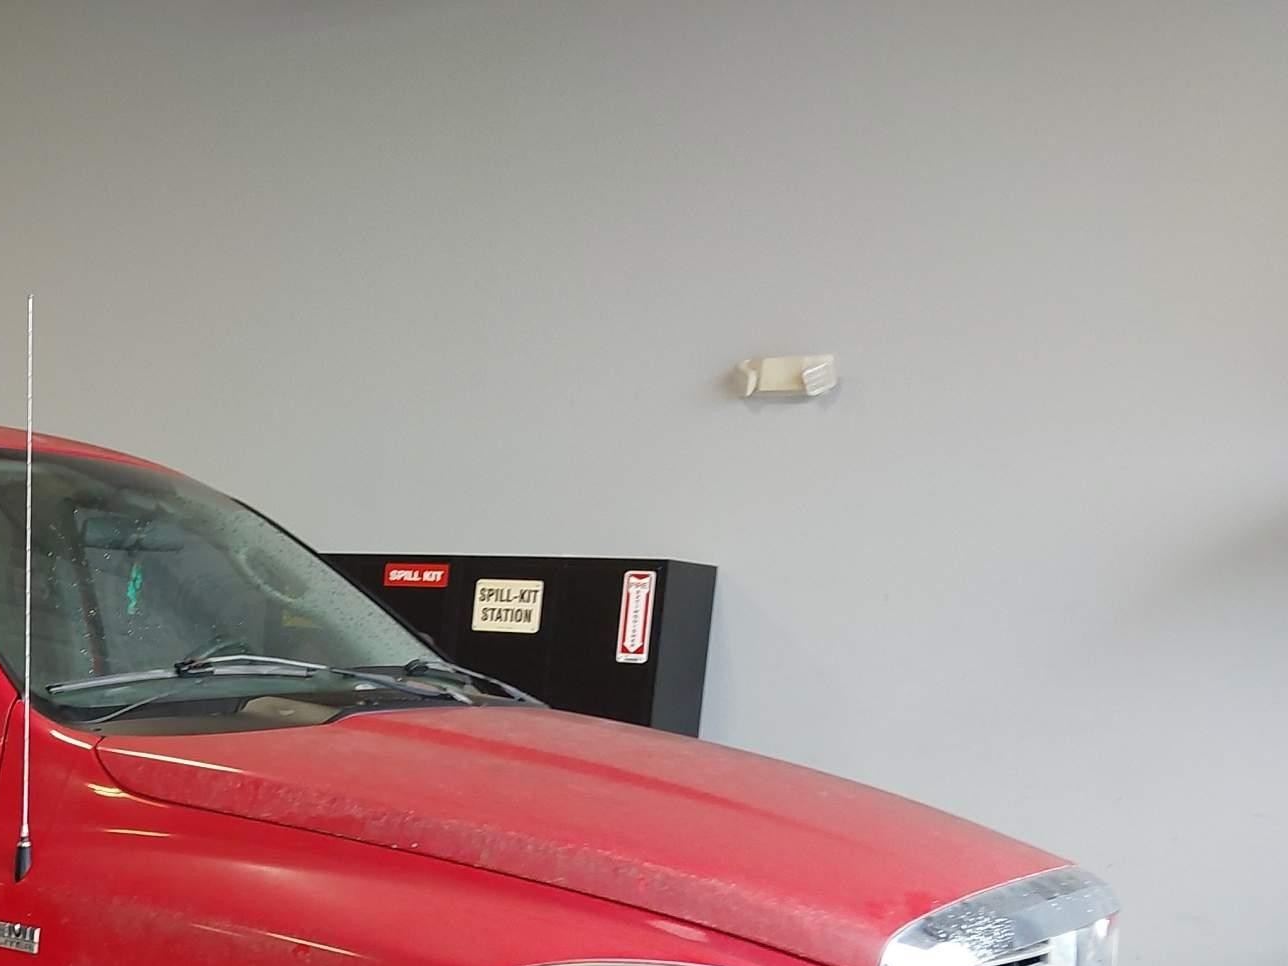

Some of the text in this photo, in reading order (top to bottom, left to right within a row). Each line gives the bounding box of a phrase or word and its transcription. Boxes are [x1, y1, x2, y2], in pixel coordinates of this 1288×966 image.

[389, 570, 444, 582] SPILL KIT
[479, 587, 539, 604] SPILL-KIT
[480, 607, 533, 623] STATION
